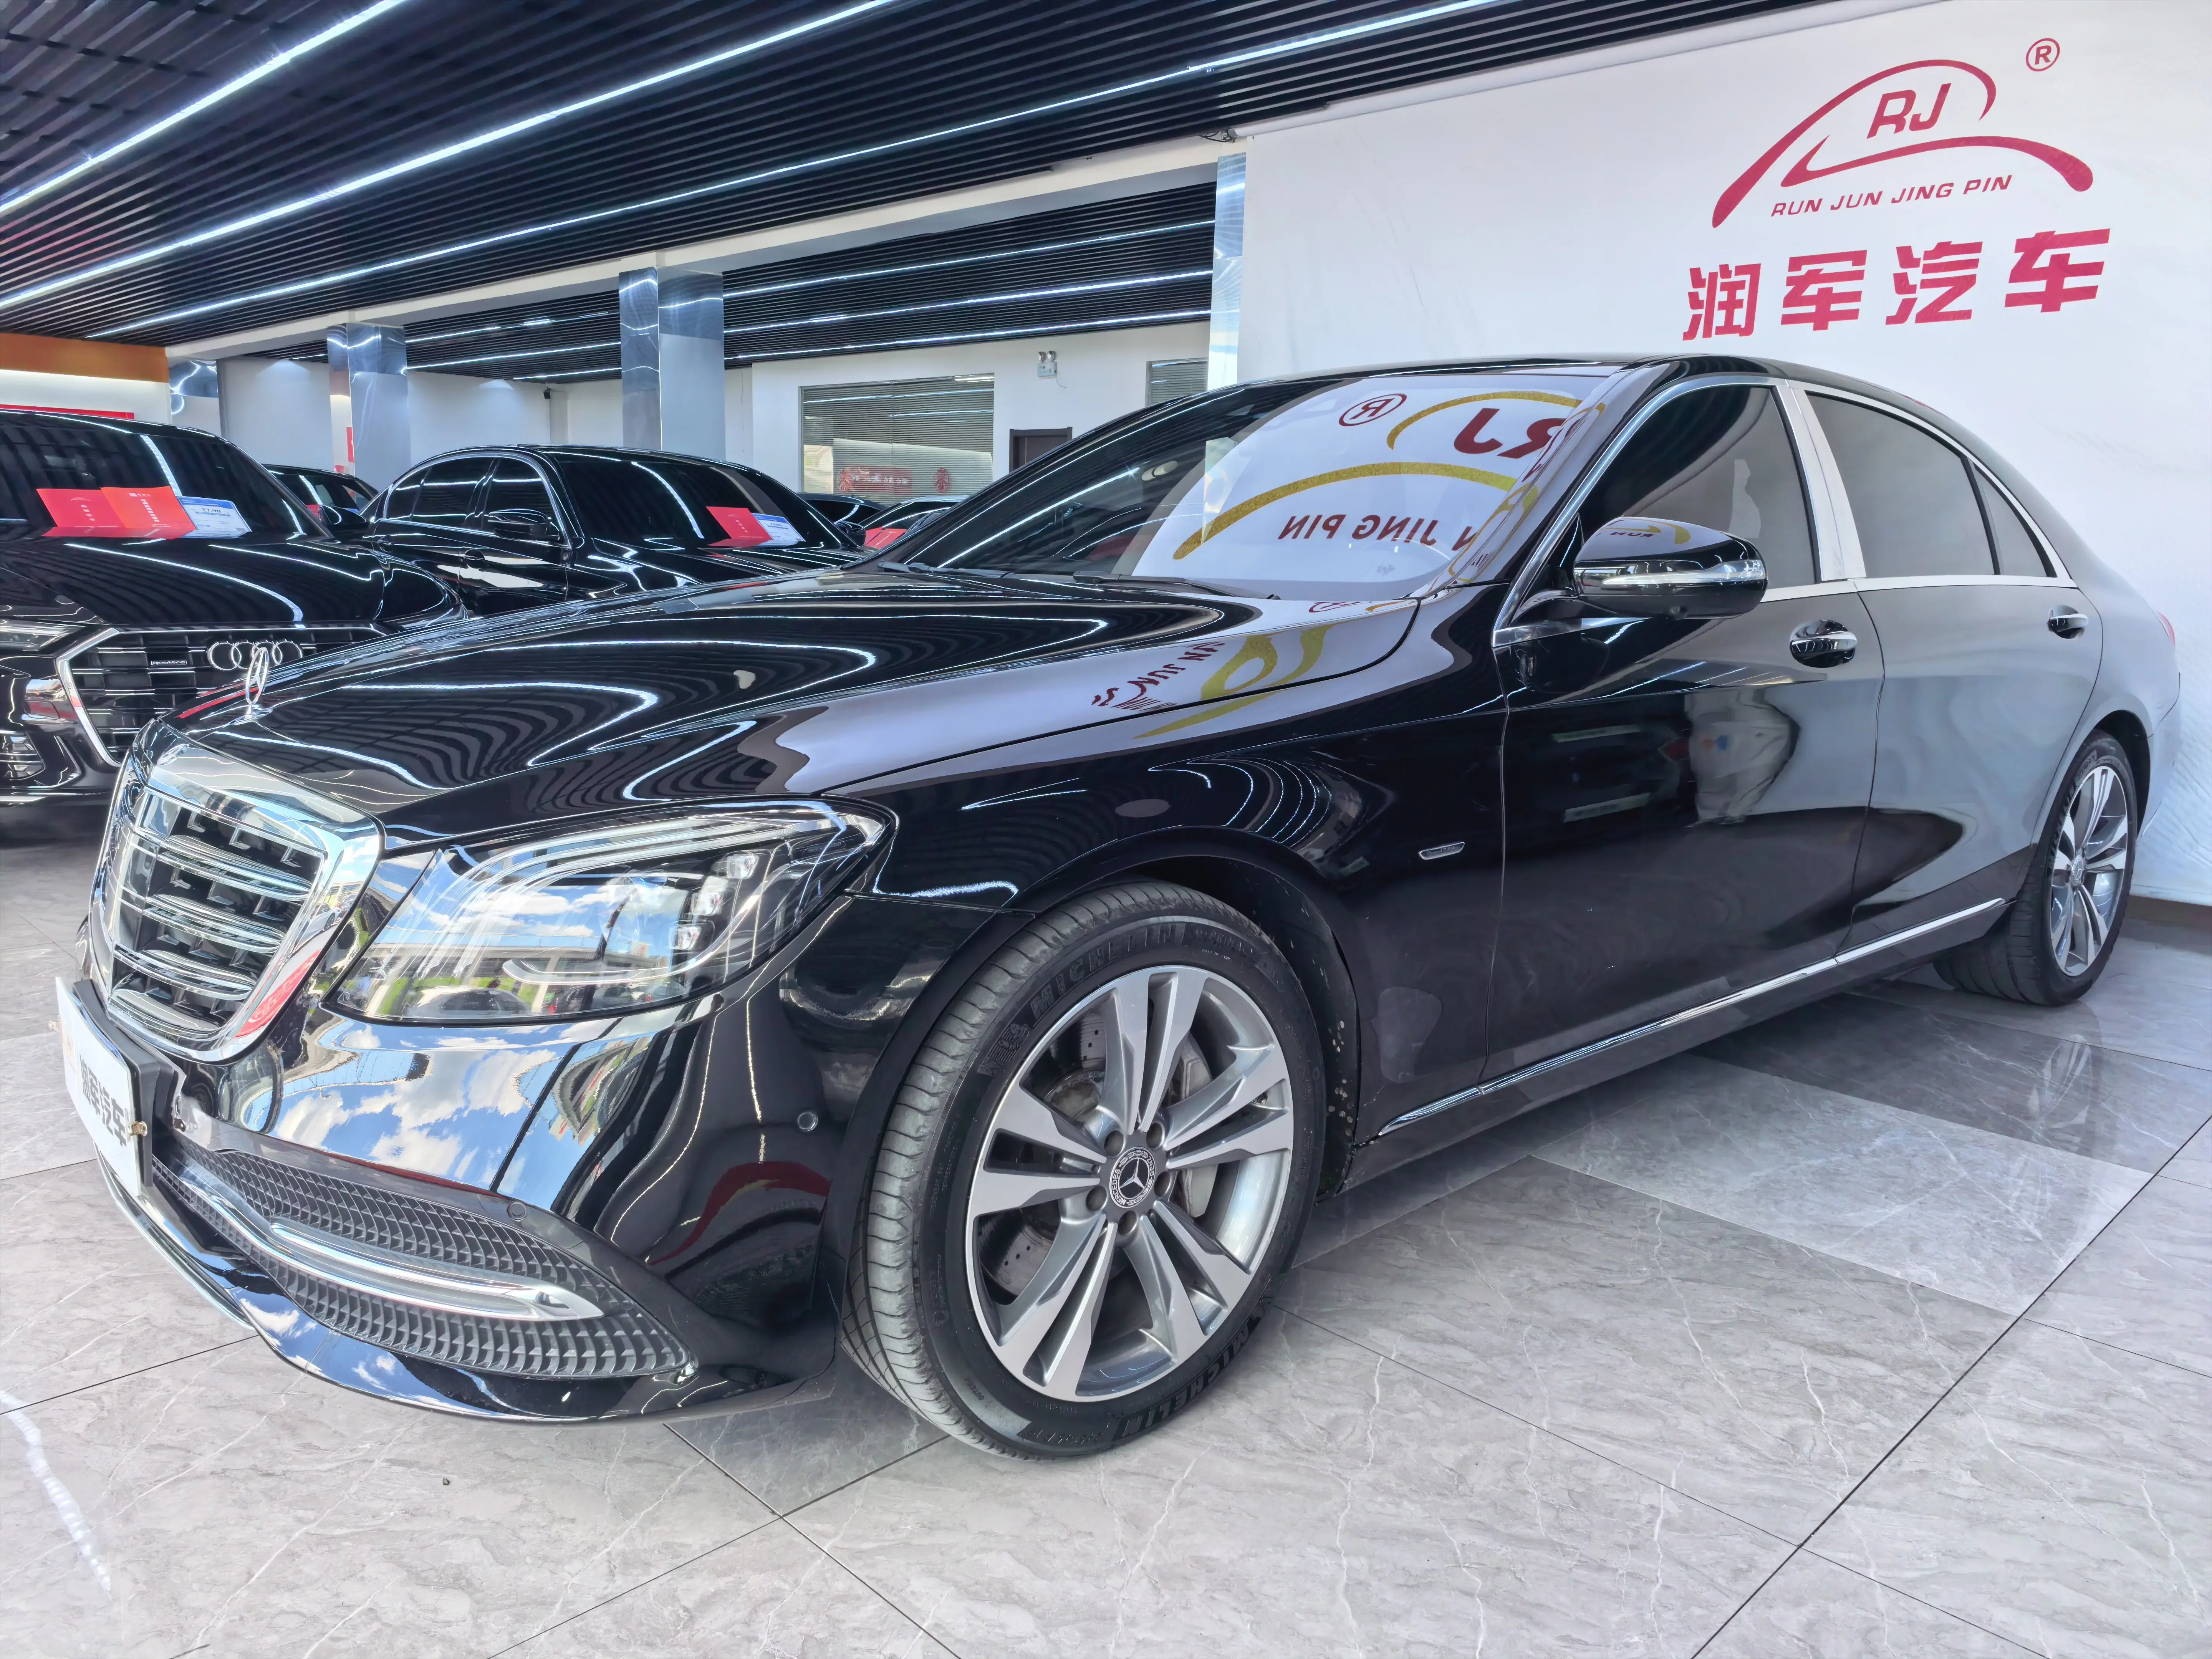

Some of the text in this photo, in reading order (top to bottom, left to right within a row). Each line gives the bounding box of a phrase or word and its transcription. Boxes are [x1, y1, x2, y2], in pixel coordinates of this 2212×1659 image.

[1866, 83, 1952, 139] RJ
[1771, 175, 2012, 217] RUN JUN JING PIN
[1682, 228, 2111, 341] 润军汽车
[1030, 922, 1186, 1019] MICHELIN
[1111, 1168, 1127, 1206] MERCEDES
[1147, 1156, 1155, 1177] BENZ
[1121, 1325, 1248, 1437] MICHELIN
